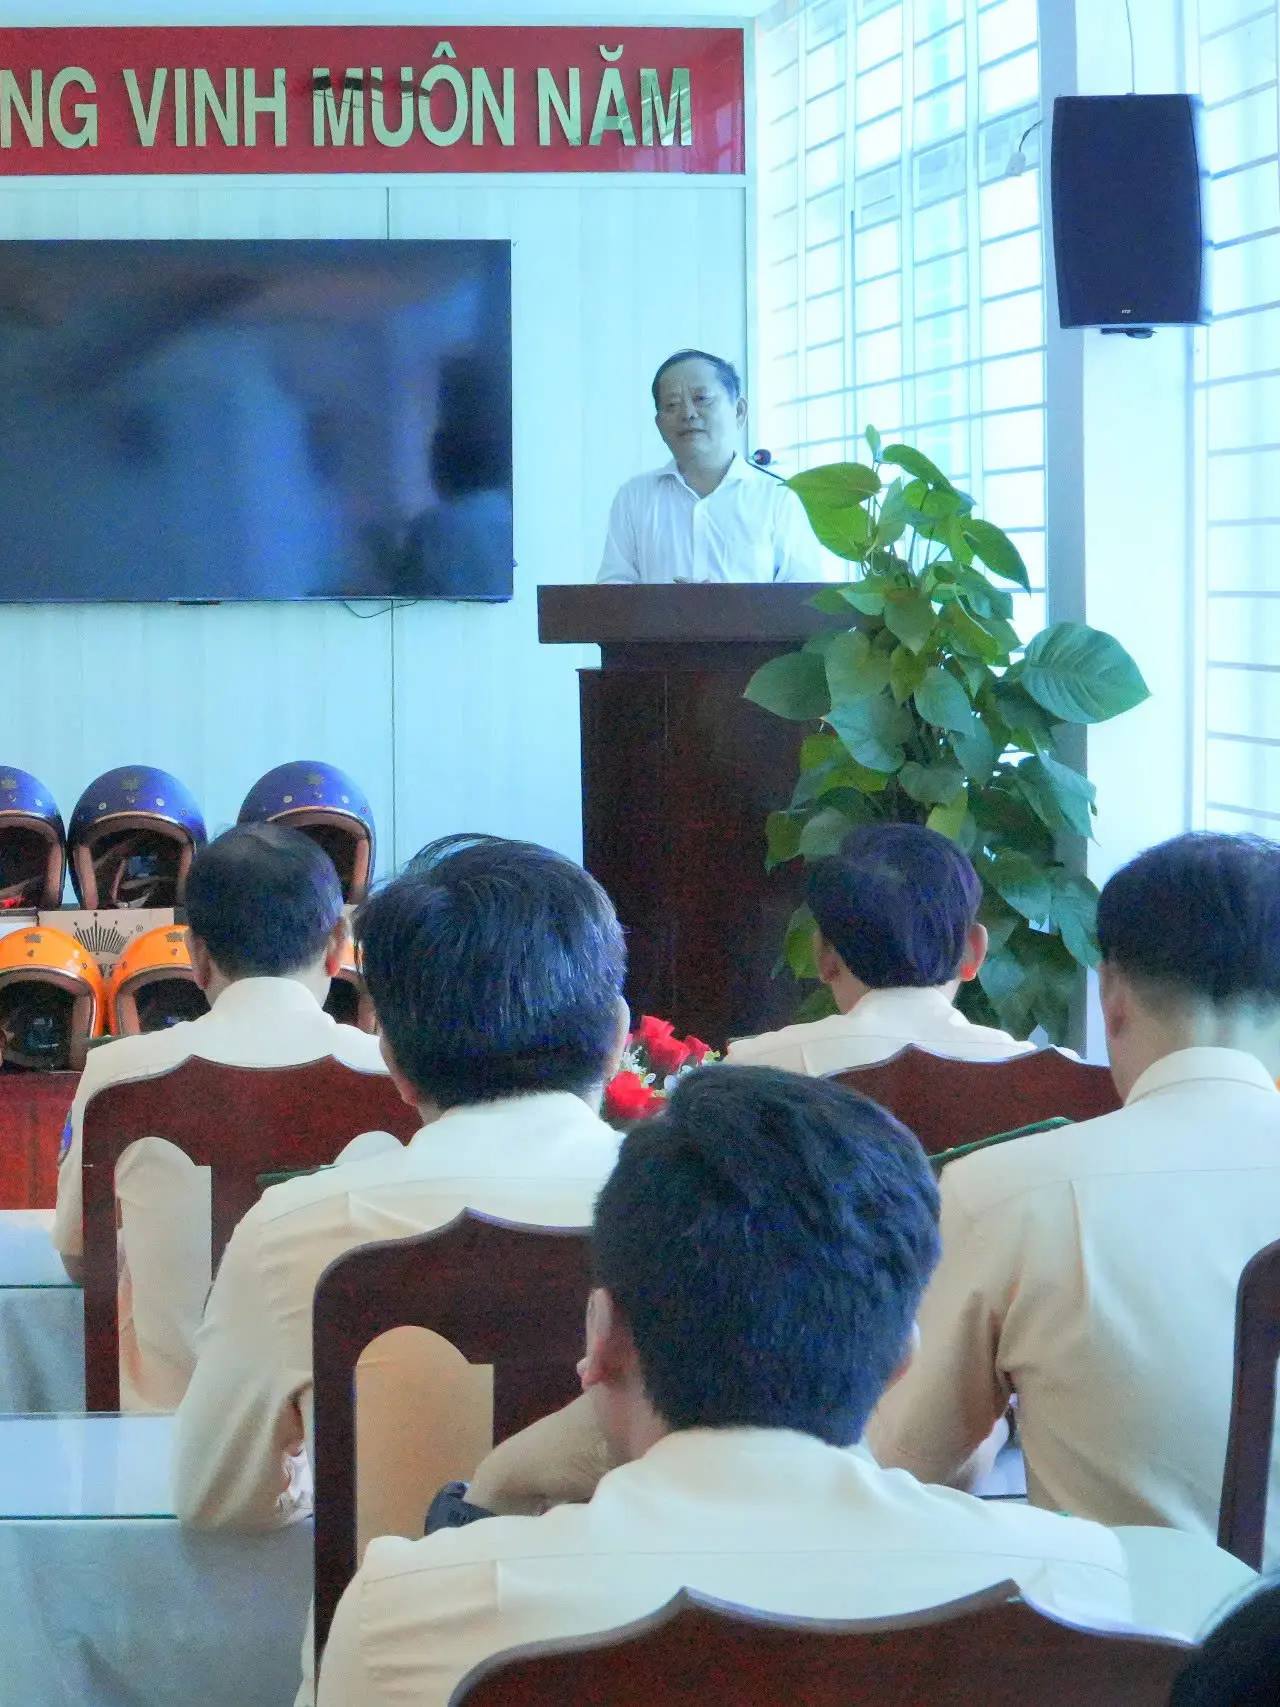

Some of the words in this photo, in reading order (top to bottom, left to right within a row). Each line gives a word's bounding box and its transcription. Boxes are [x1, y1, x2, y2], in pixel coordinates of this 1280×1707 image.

[122, 67, 287, 147] VINH
[312, 41, 515, 147] MUÔN
[537, 44, 692, 146] NĂM
